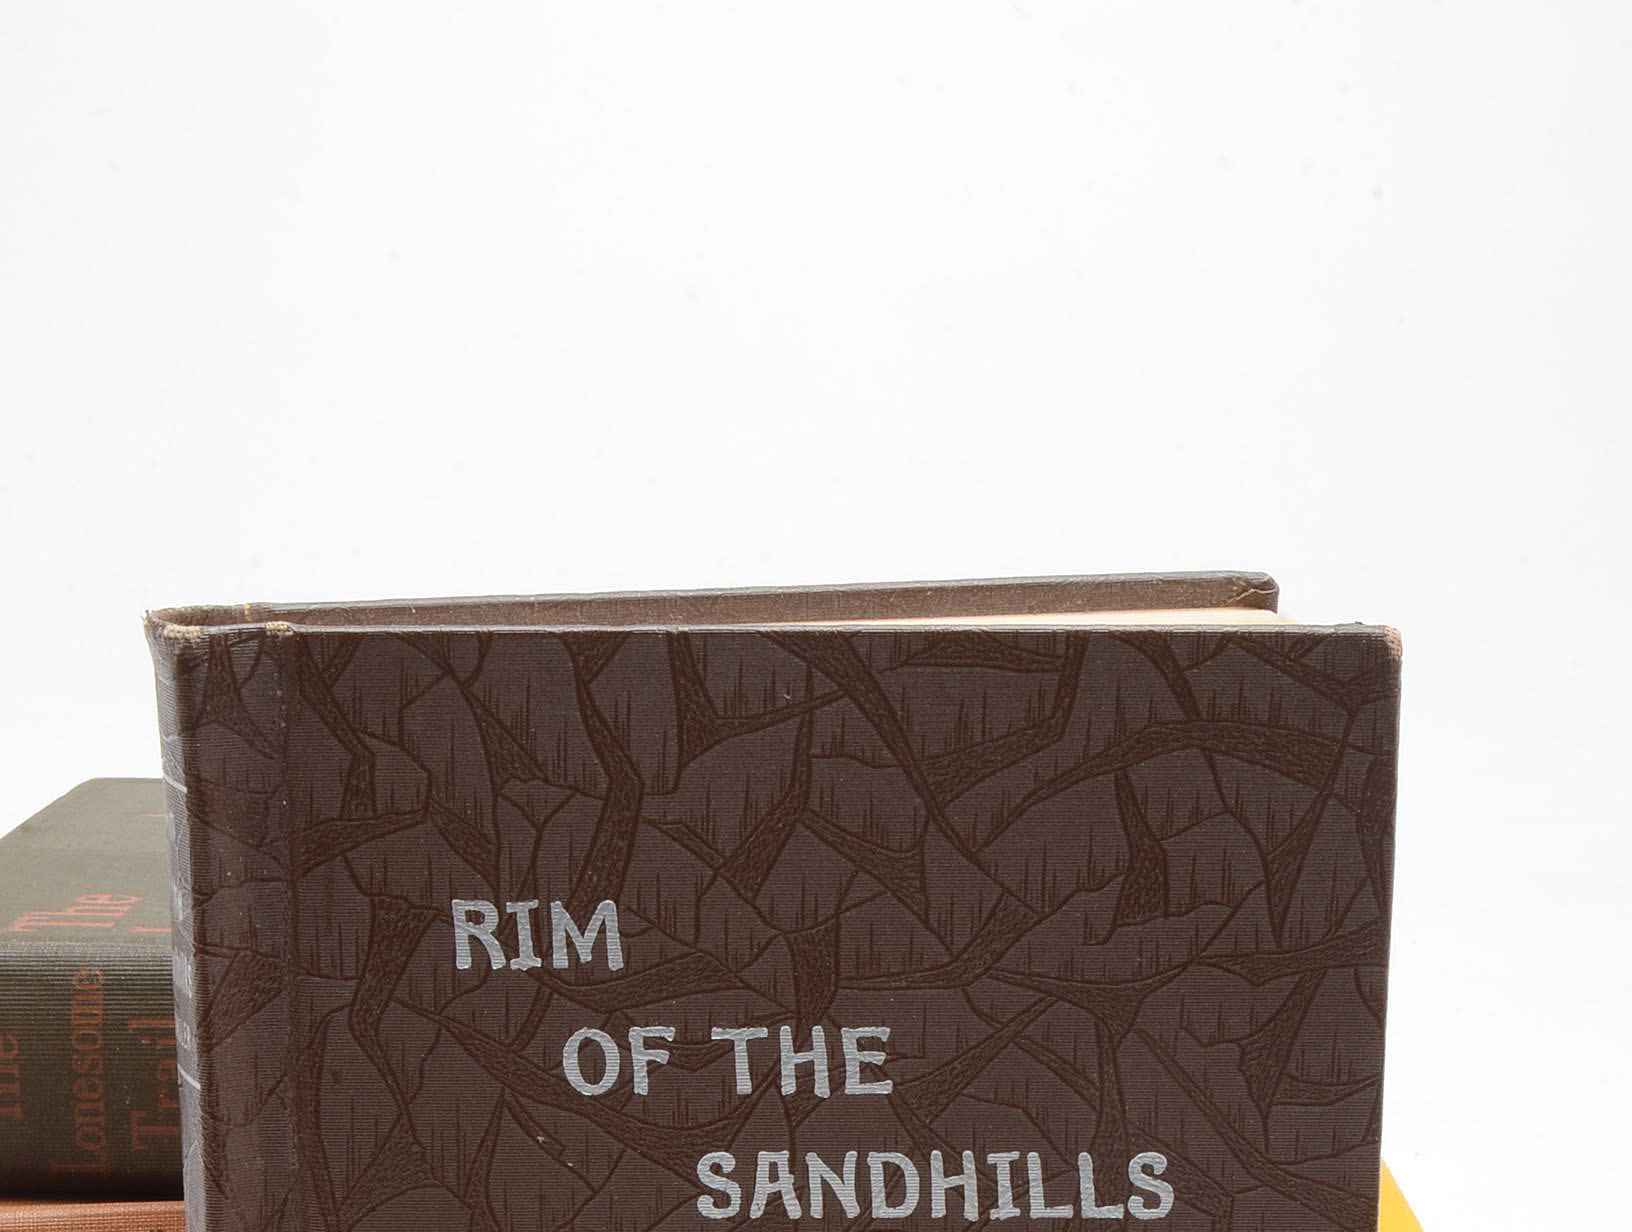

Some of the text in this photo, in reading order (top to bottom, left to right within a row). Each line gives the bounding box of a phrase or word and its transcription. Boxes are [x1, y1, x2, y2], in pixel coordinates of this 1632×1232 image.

[5, 892, 142, 934] The
[451, 898, 625, 972] RIM
[51, 966, 107, 1175] Lonesome
[562, 1025, 894, 1098] OF THE
[696, 1149, 1176, 1220] SANDHILLS
